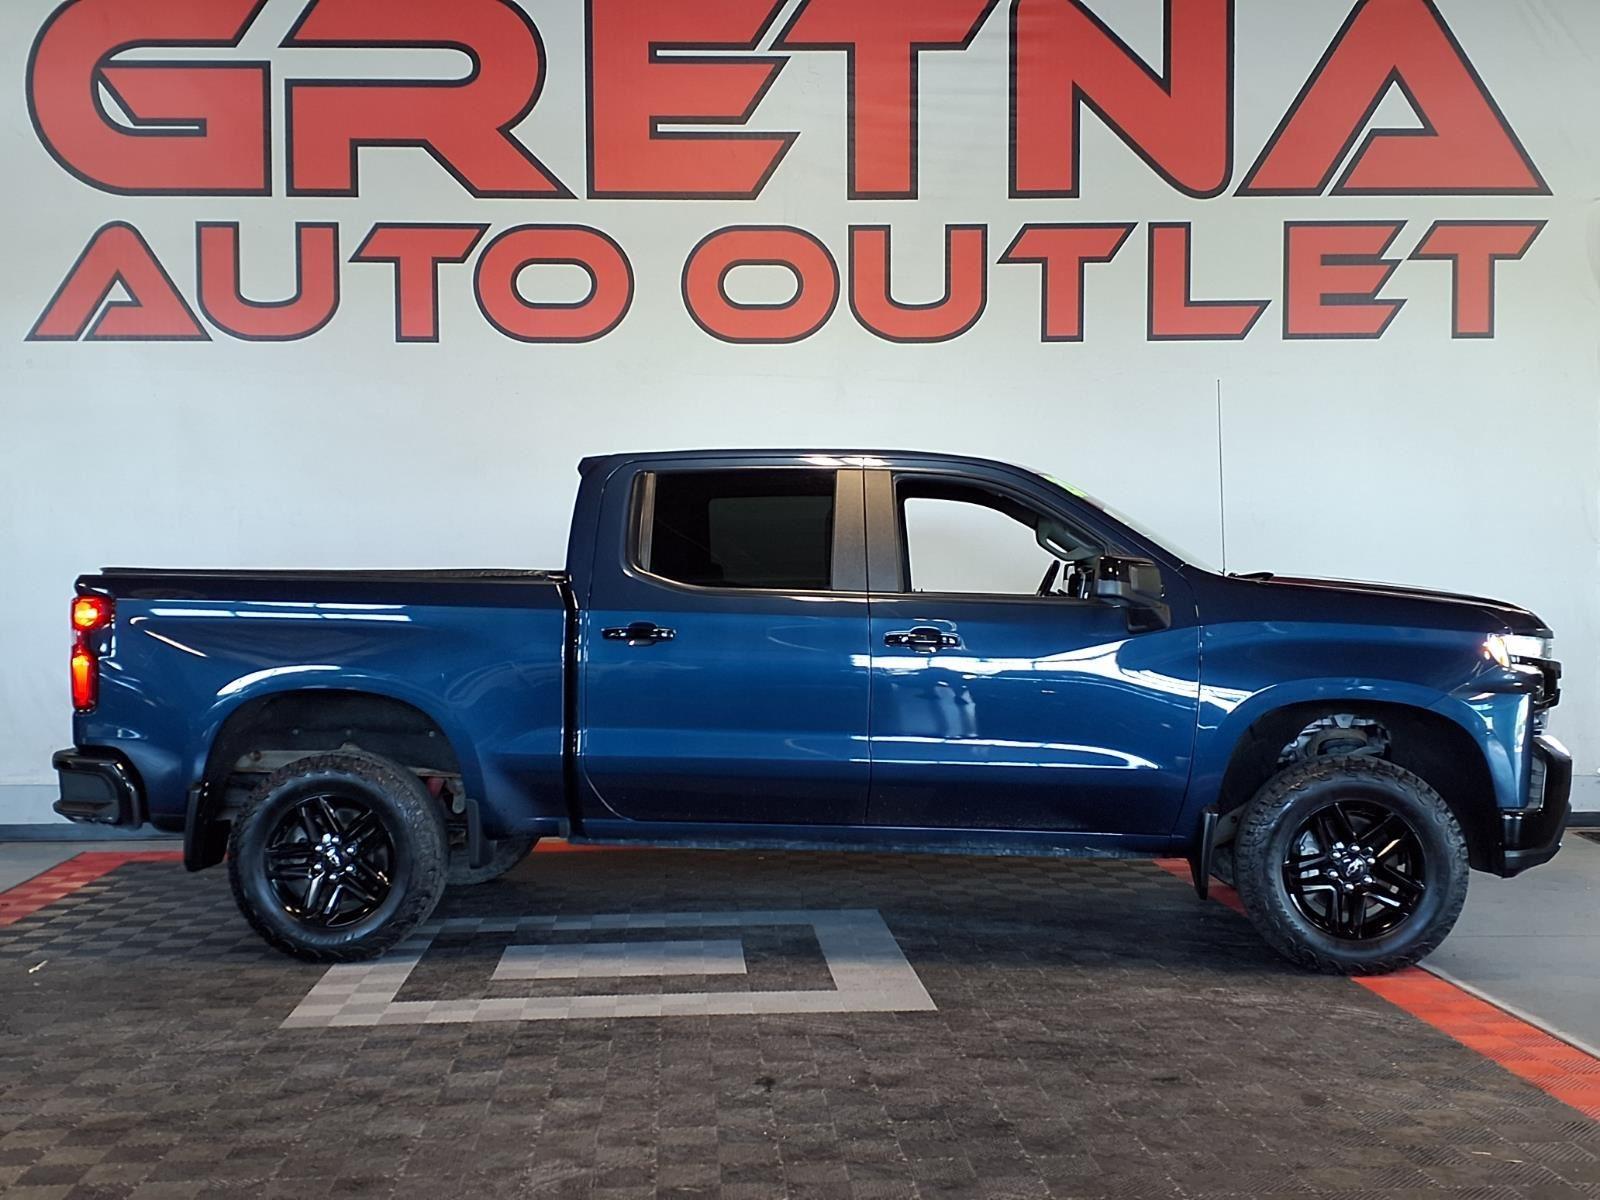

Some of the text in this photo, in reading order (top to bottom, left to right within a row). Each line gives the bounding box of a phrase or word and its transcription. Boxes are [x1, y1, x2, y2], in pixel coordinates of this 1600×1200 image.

[26, 0, 1553, 199] GRETNA
[24, 219, 1549, 343] AUTO OUTLET
